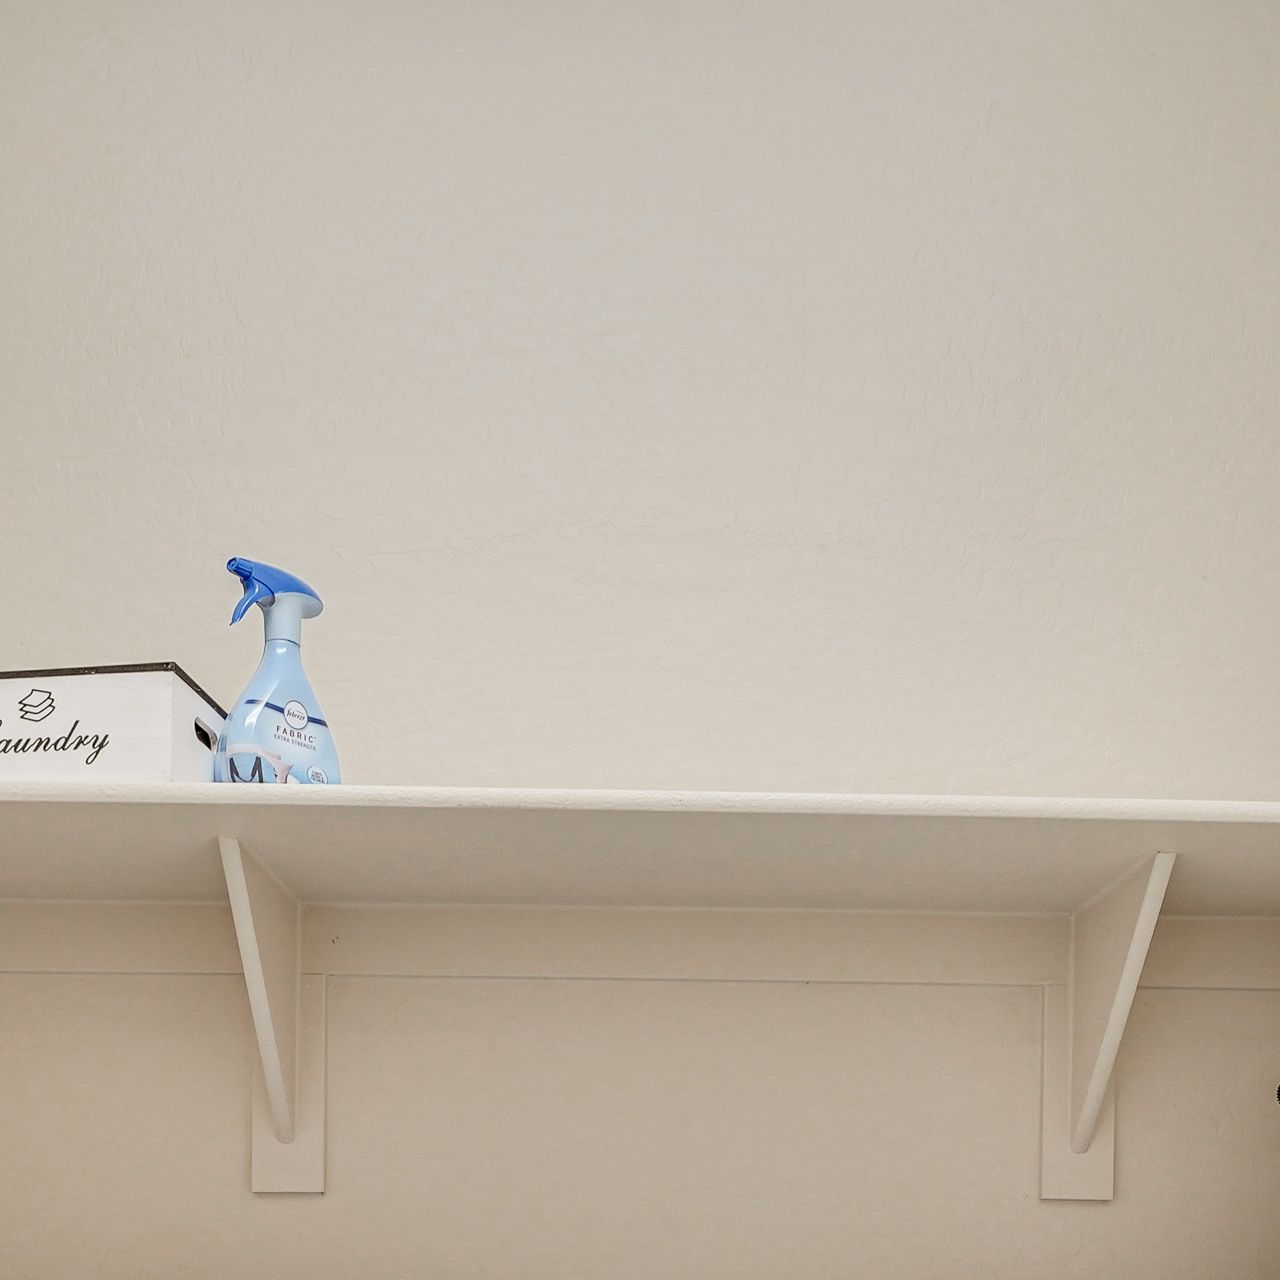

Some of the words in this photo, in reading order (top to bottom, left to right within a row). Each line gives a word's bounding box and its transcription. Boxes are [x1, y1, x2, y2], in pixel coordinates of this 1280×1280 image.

[273, 734, 290, 744] EXTRA
[291, 738, 317, 751] STRENGTH
[276, 725, 315, 744] FABRIC
